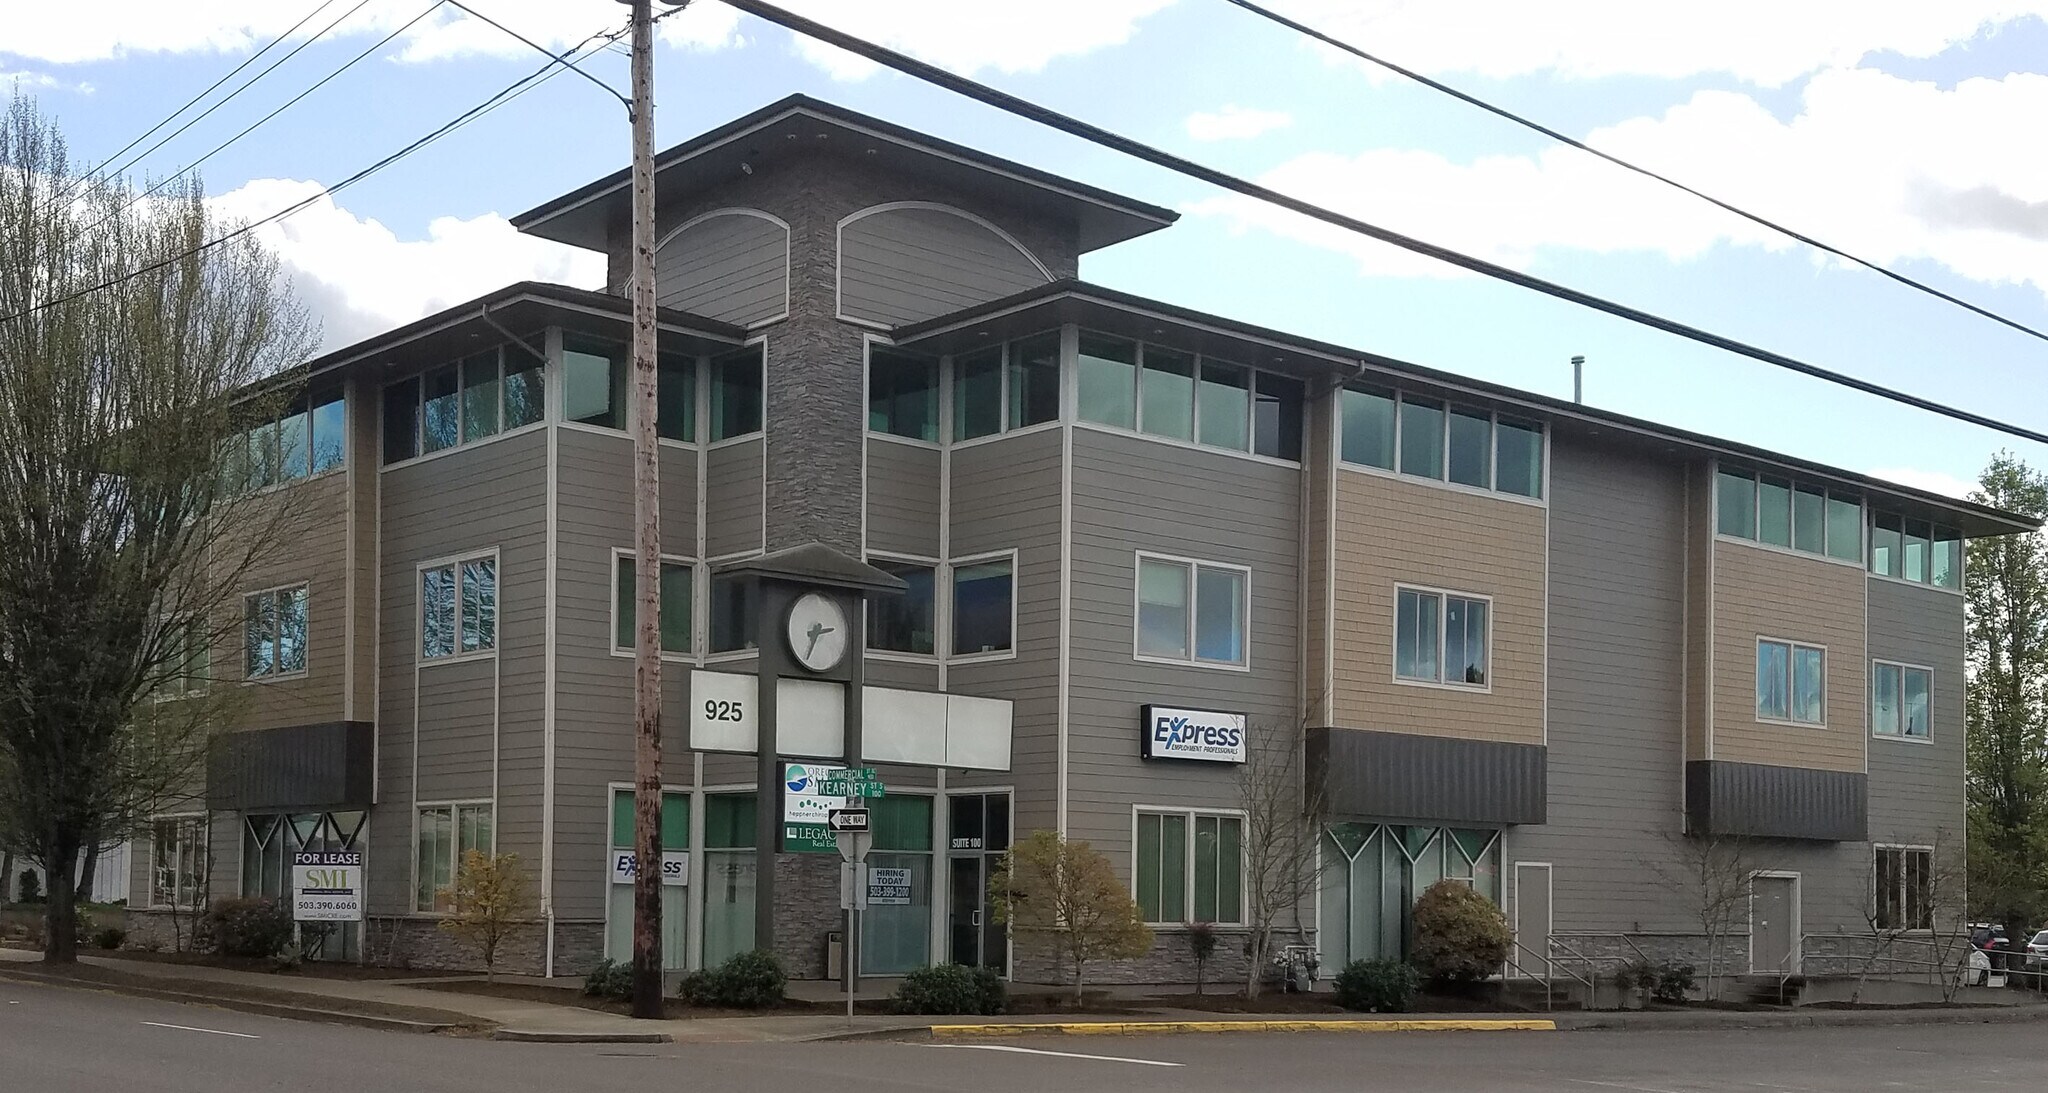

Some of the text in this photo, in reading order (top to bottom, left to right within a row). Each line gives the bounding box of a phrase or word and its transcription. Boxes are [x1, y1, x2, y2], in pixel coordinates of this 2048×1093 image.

[705, 700, 743, 722] 925
[1154, 716, 1241, 750] Express
[1171, 744, 1239, 755] EMPLOYMENT PROFESSIONALS
[829, 769, 865, 780] COMMERCIAL
[820, 781, 867, 796] KEARNEY
[840, 815, 865, 824] ONE WAY
[799, 827, 836, 840] LEGAC
[952, 838, 982, 848] SUITE 100
[295, 853, 360, 864] FOR LEASE
[877, 869, 904, 877] HIRING
[305, 869, 349, 889] SMI
[877, 877, 904, 885] TODAY
[870, 886, 910, 897] 503-399-1200
[298, 901, 357, 910] 503.390.6060
